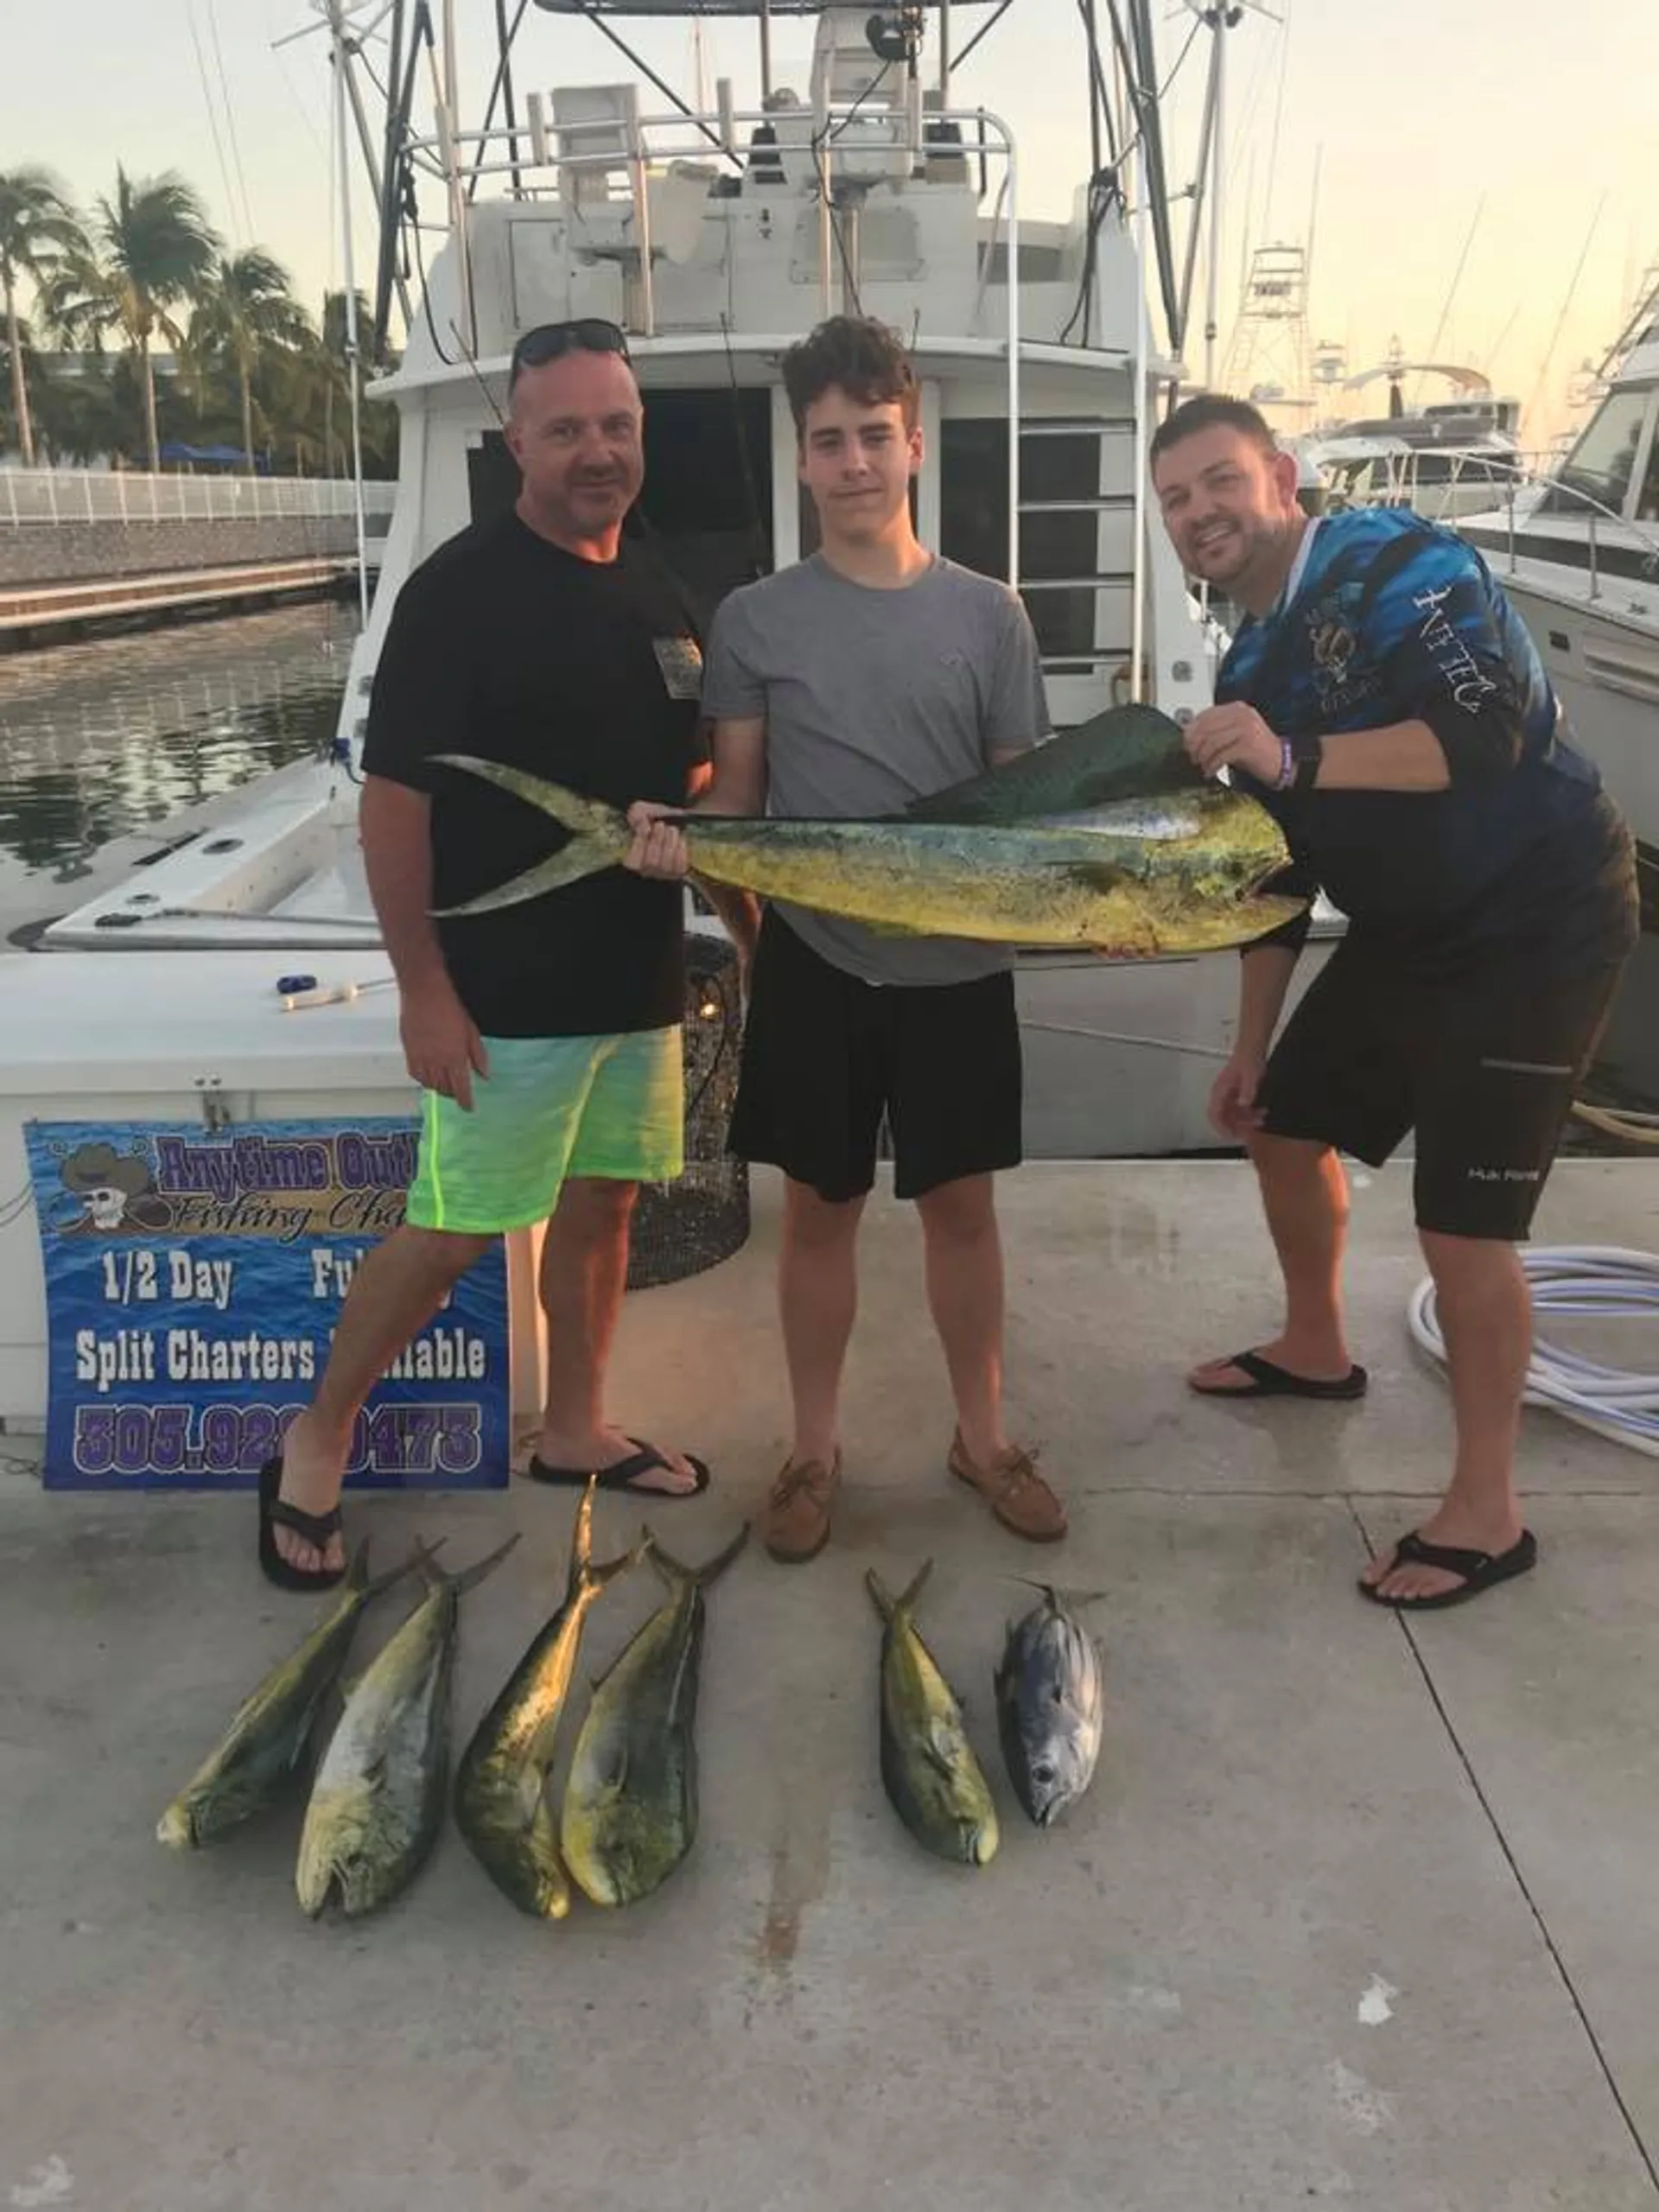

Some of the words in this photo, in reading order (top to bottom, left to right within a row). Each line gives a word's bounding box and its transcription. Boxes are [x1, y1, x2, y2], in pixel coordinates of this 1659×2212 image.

[156, 1136, 330, 1205] Anytime
[175, 1192, 313, 1243] Fishing
[329, 1189, 408, 1230] Cha
[103, 1250, 157, 1306] 1/2
[169, 1250, 232, 1311] Day
[311, 1249, 364, 1299] Fu
[76, 1330, 155, 1393] Split
[168, 1329, 315, 1380] Charters
